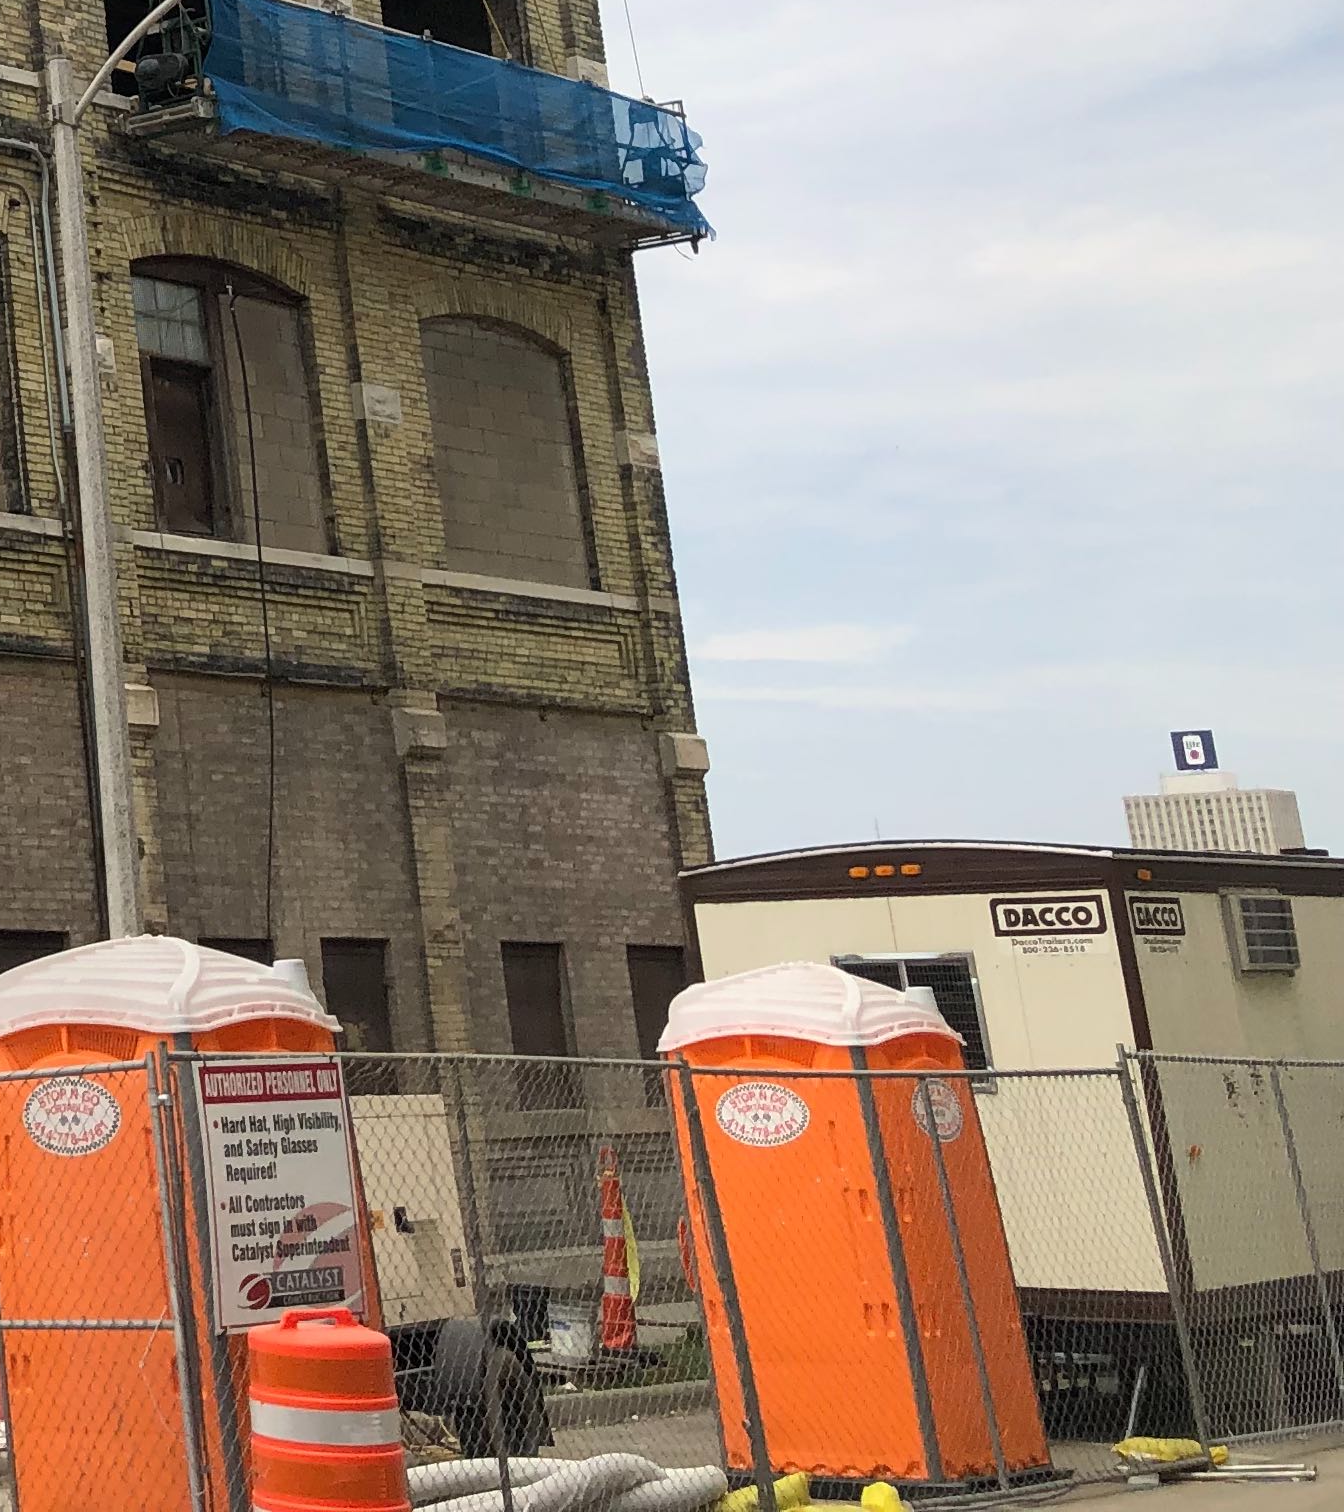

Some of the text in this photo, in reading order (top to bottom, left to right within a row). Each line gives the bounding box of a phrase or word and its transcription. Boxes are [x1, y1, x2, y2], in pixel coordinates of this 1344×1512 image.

[1003, 906, 1093, 927] DACCO
[1136, 907, 1178, 926] DACCO
[204, 1069, 337, 1097] AUTHORIZED PERSONNEL ONLY
[38, 1088, 66, 1108] STOP
[82, 1091, 99, 1106] GO
[729, 1090, 787, 1108] STOP N GO
[221, 1112, 341, 1135] Hard Hat, High Visibility,
[224, 1137, 318, 1158] and Safety Glasses
[226, 1161, 277, 1185] Required!
[229, 1194, 305, 1213] All Contractors
[231, 1214, 317, 1238] must sign in with
[232, 1236, 350, 1263] Catalyst Superintendent
[277, 1269, 340, 1290] CATALYST
